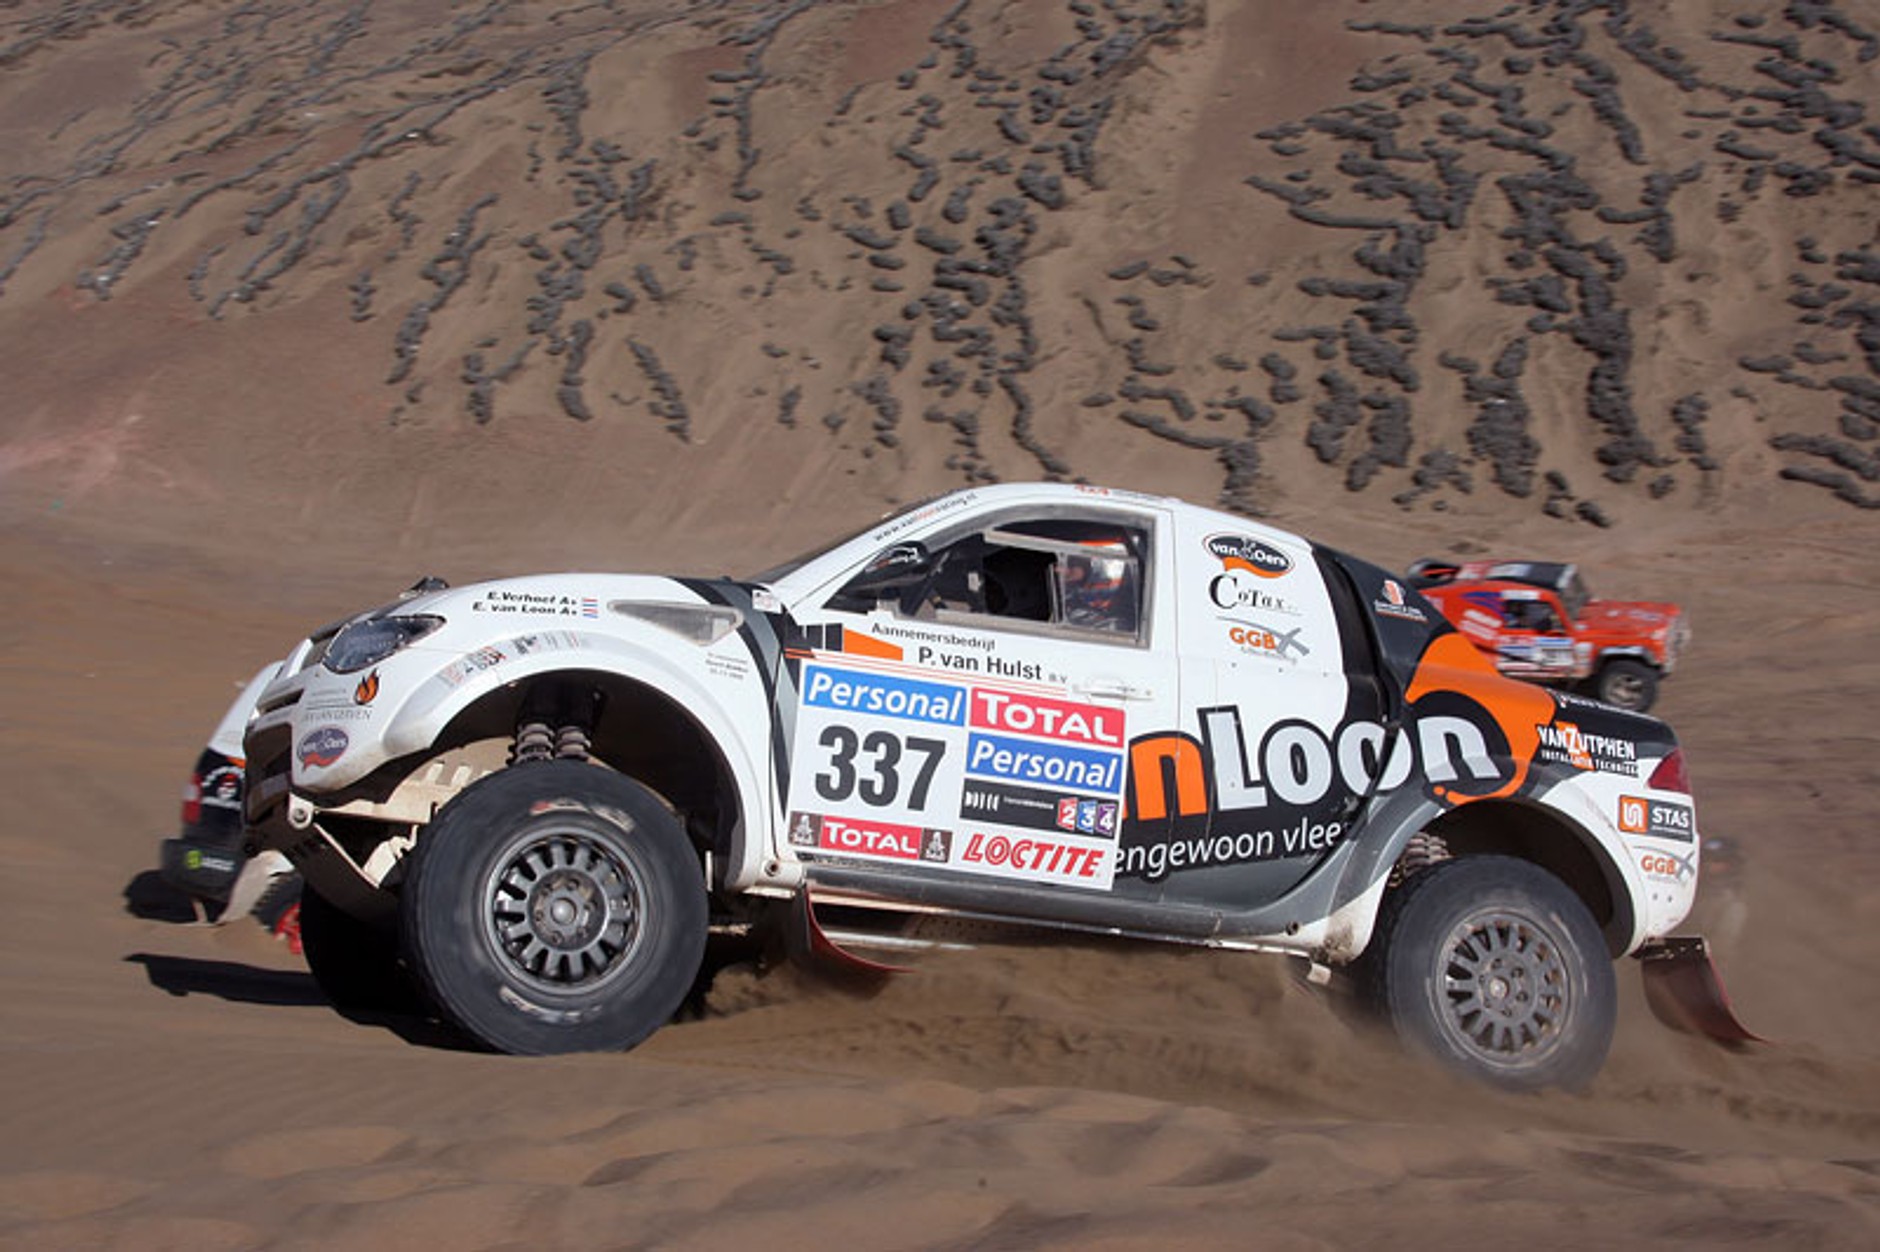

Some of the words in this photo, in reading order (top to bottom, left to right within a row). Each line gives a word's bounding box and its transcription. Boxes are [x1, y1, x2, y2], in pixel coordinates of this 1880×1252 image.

[1211, 541, 1238, 557] van
[472, 601, 486, 612] E.
[491, 604, 517, 612] van
[521, 604, 556, 615] Loon
[871, 622, 996, 652] Aannemersbedrijf
[1229, 626, 1276, 650] GGB
[918, 645, 936, 666] P.
[940, 652, 979, 671] van
[986, 656, 1042, 681] Hulst
[808, 671, 963, 722] Personal
[977, 691, 1119, 744] TOTAL
[815, 724, 947, 812] 337
[970, 739, 1119, 789] Personal
[1651, 805, 1690, 828] STAS
[824, 821, 918, 854] TOTAL
[962, 833, 1105, 877] LOCTITE
